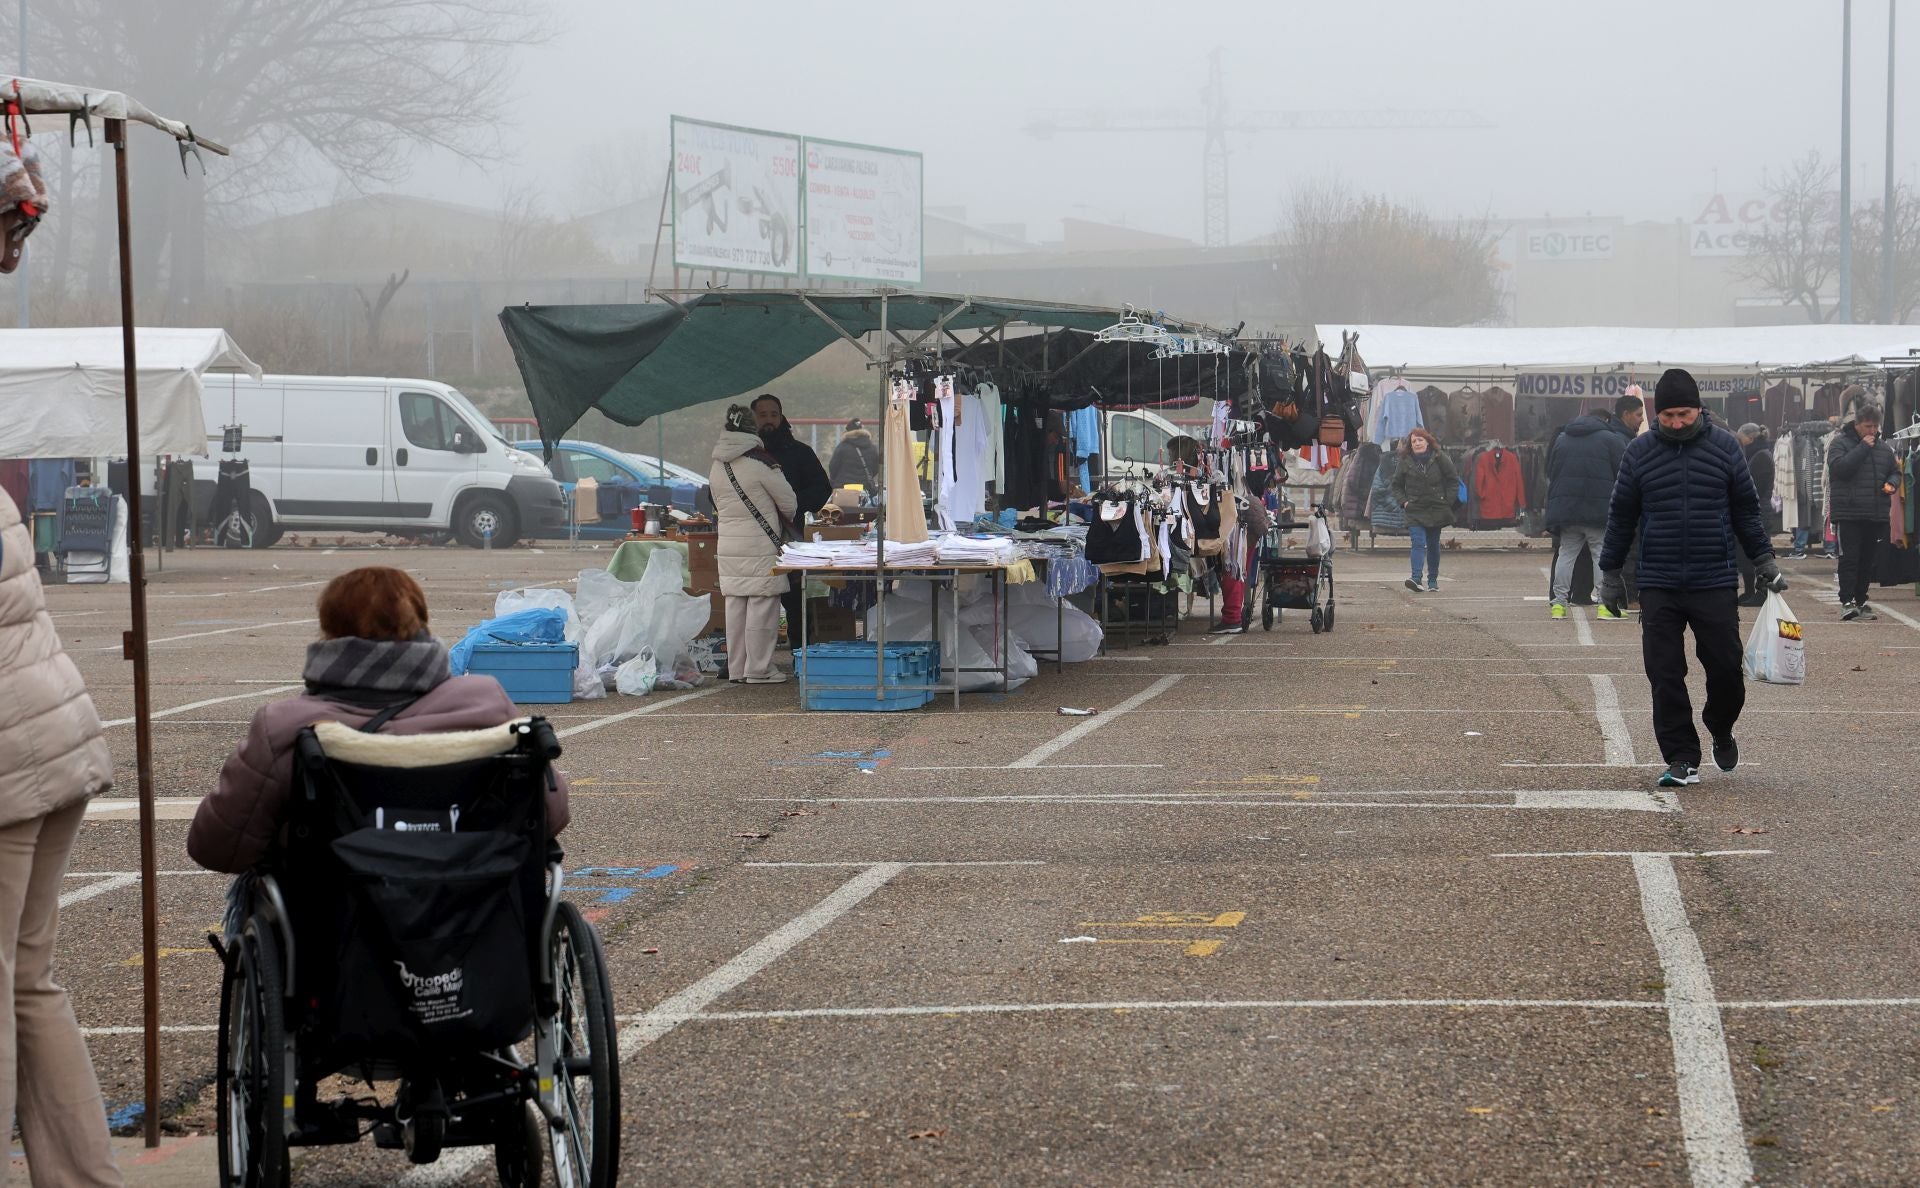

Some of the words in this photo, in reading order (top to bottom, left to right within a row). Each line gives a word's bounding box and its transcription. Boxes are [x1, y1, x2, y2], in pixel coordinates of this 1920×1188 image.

[677, 151, 702, 176] 240€
[771, 155, 797, 177] 550€
[1529, 233, 1612, 256] ENTEC
[1519, 375, 1585, 394] MODAS
[1698, 380, 1731, 392] CIALES
